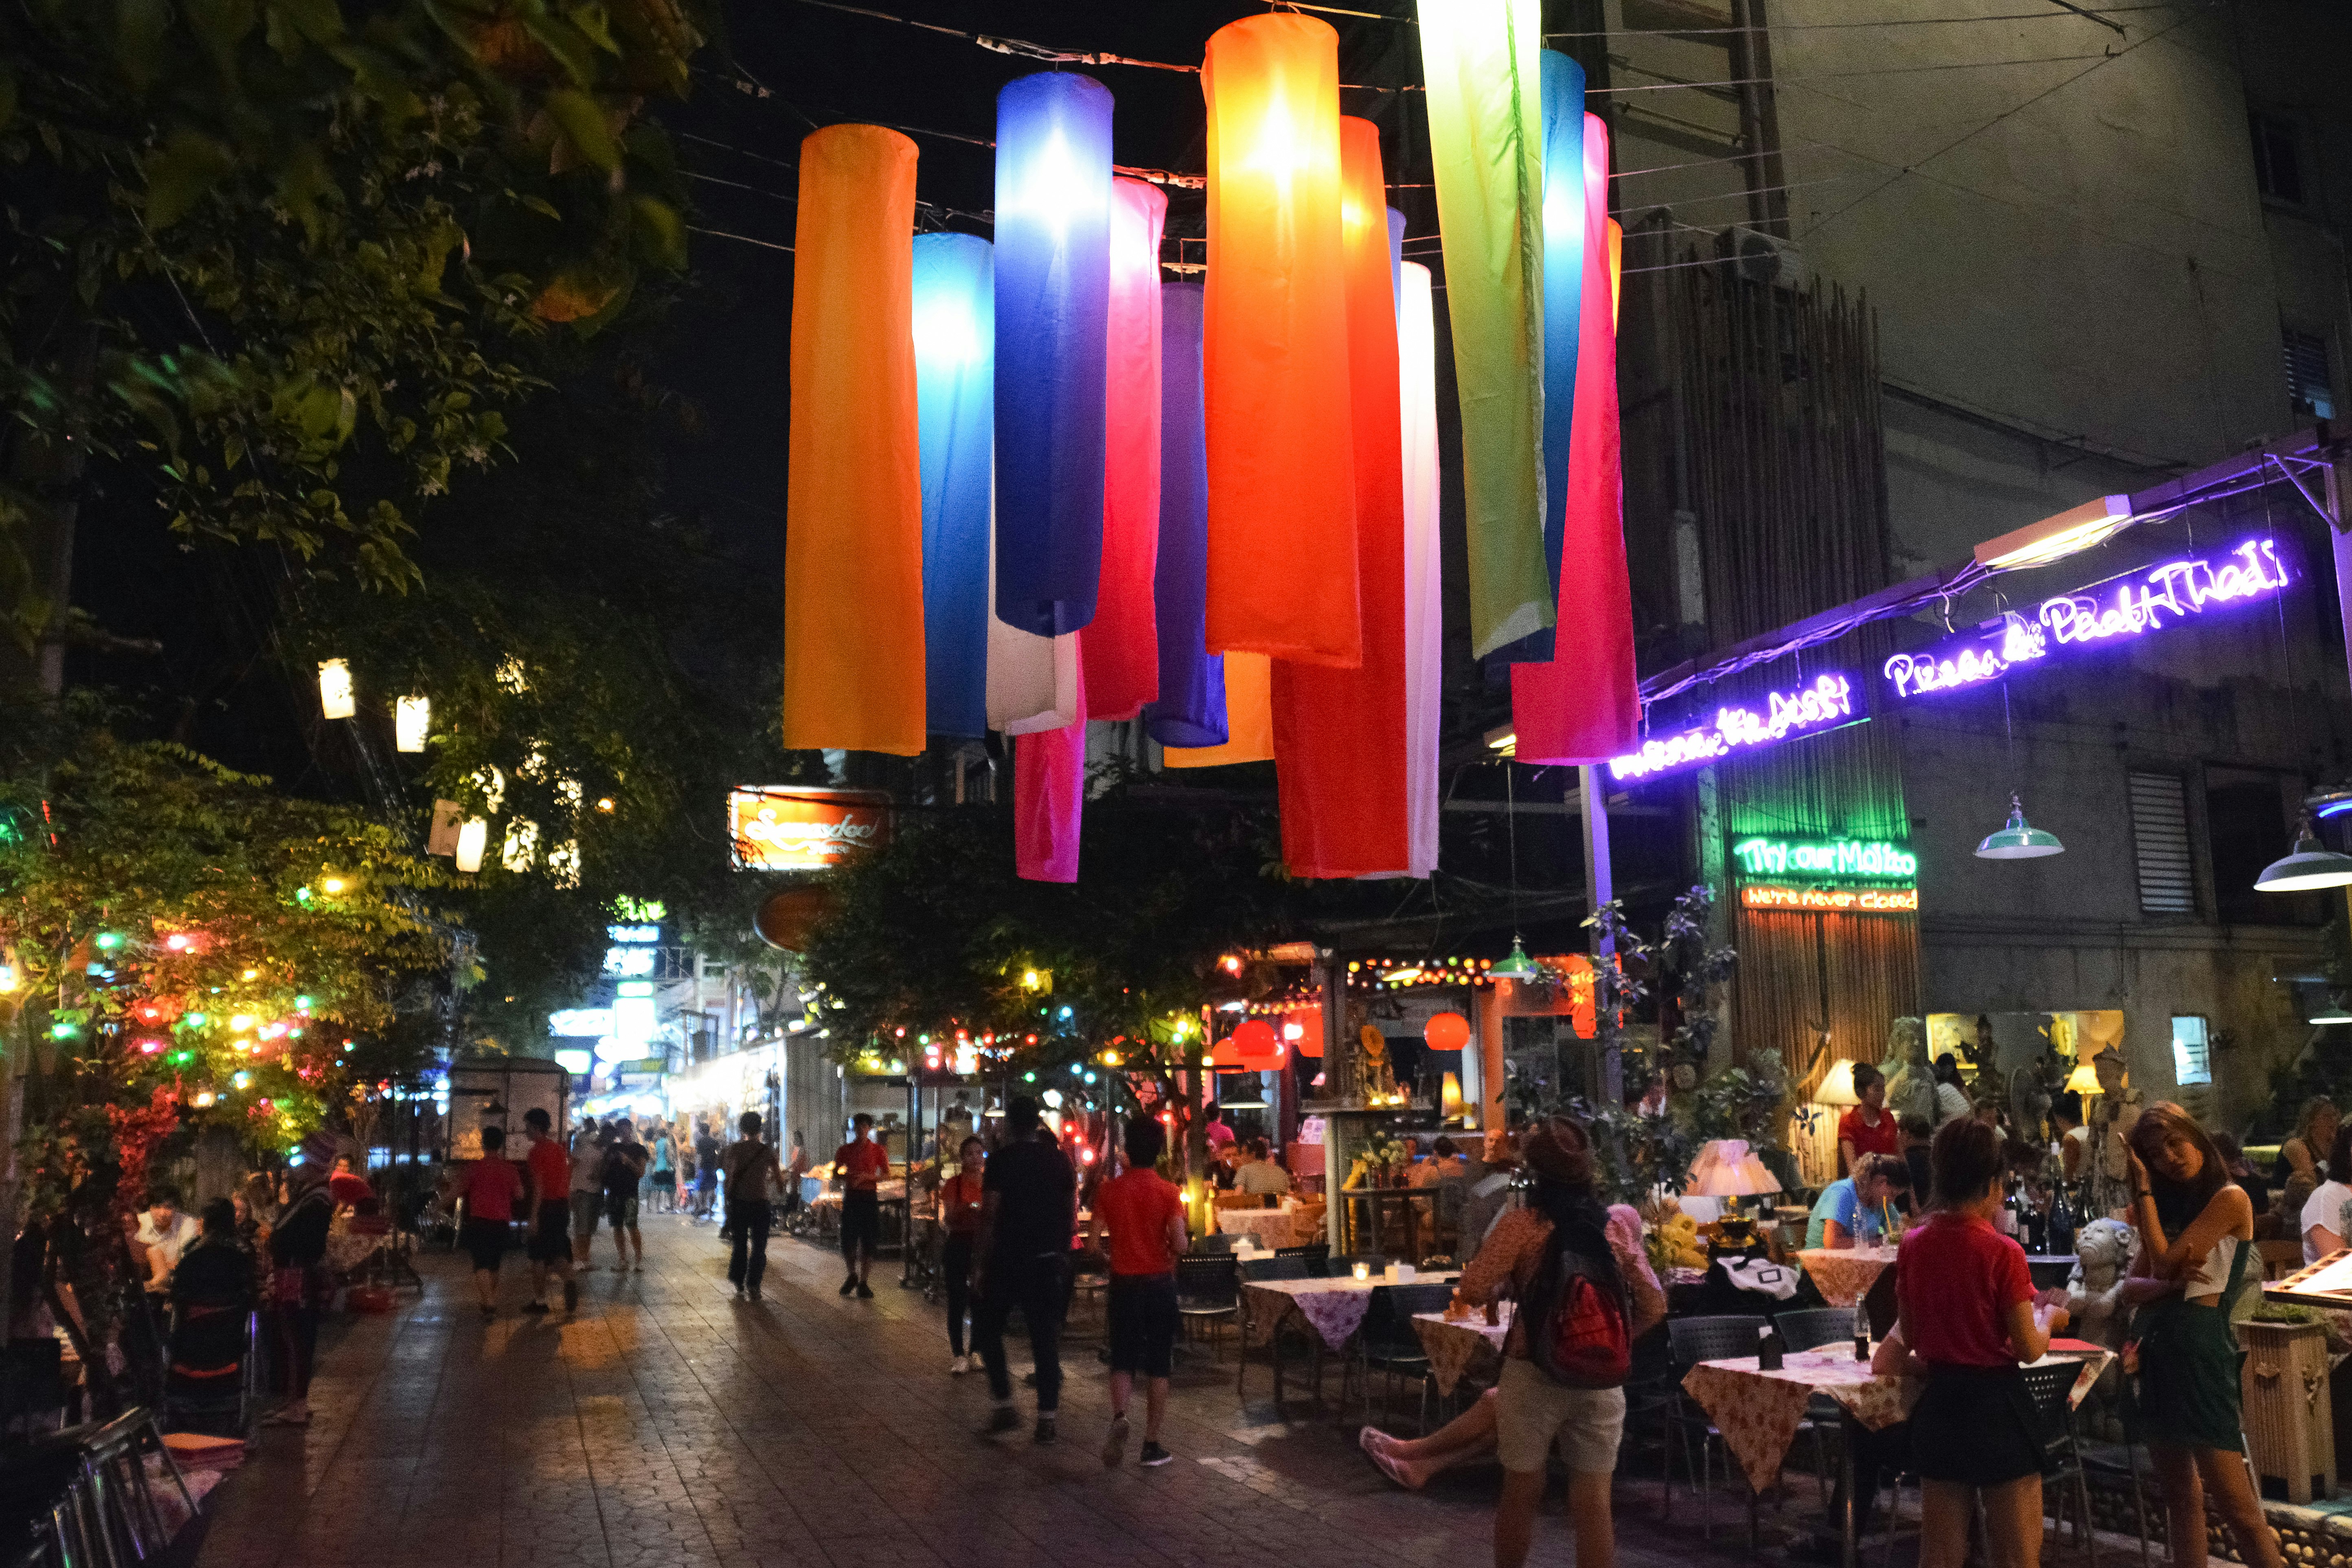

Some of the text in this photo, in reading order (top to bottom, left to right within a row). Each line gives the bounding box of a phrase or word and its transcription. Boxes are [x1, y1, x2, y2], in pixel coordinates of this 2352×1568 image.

[1742, 839, 1787, 873] Try
[1795, 846, 1836, 869] our
[1802, 892, 1856, 907] never
